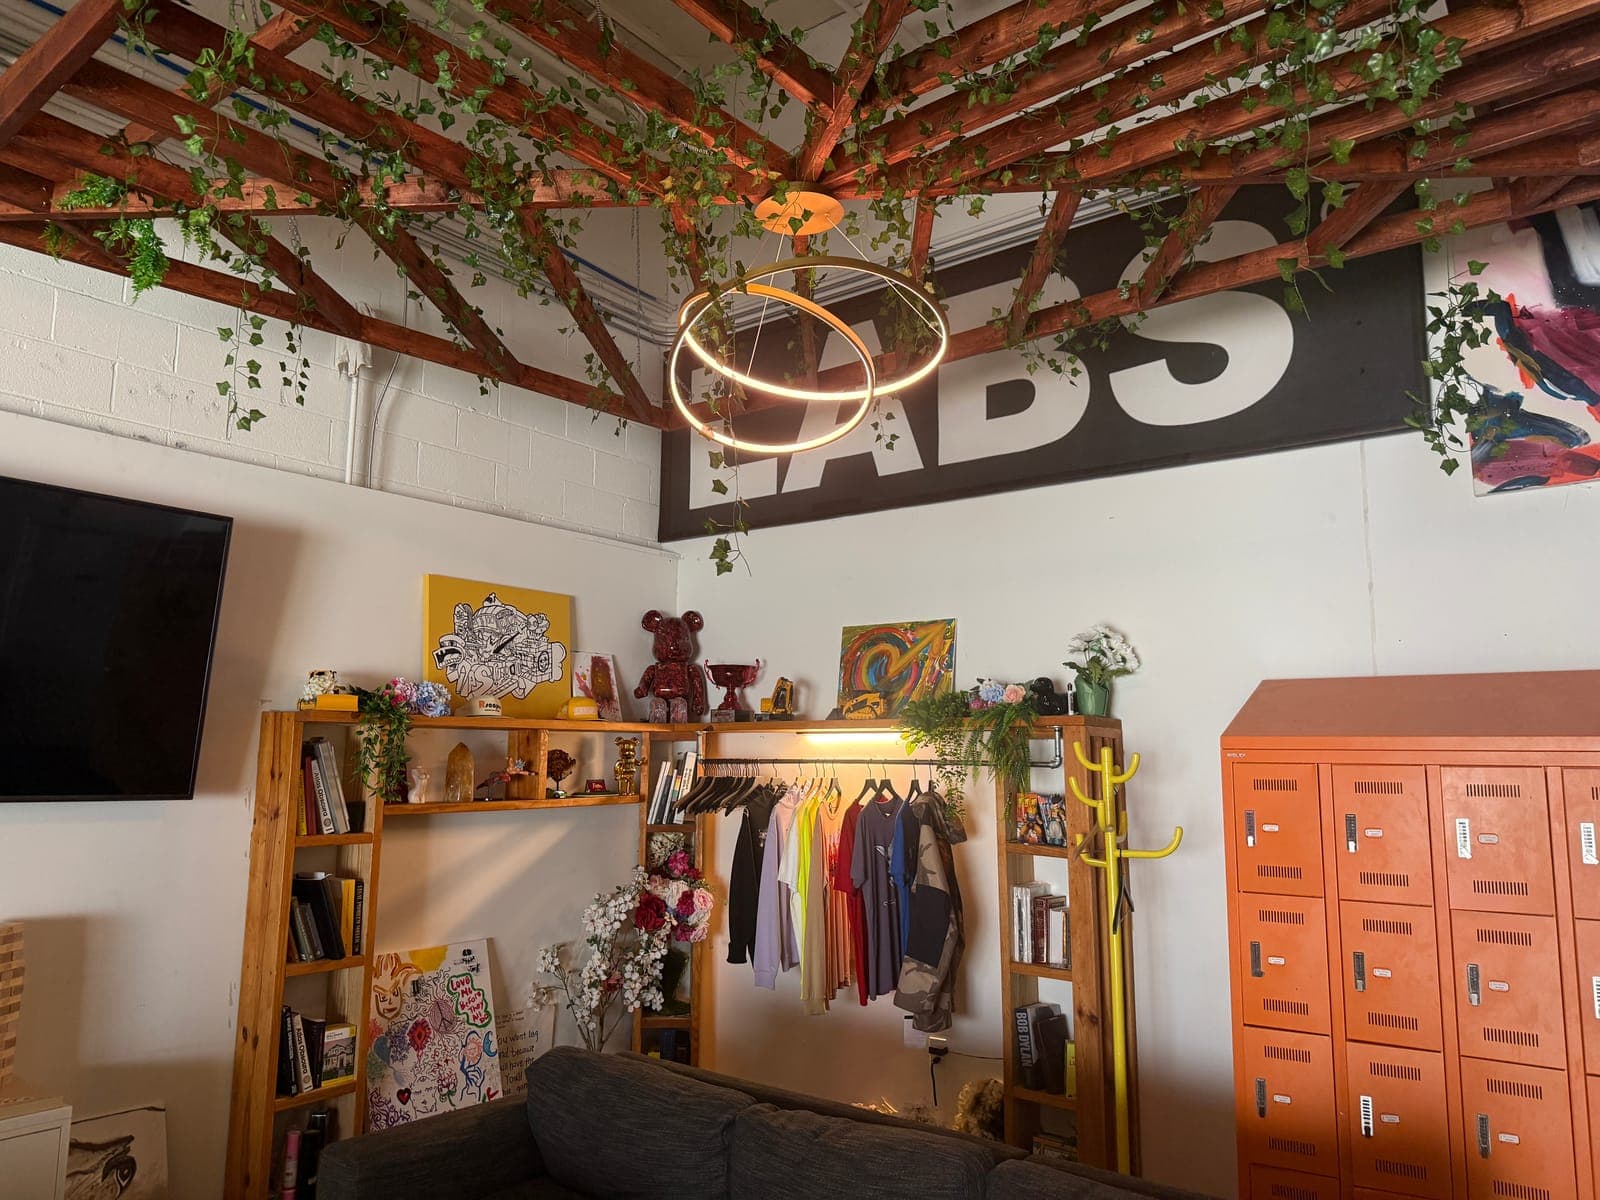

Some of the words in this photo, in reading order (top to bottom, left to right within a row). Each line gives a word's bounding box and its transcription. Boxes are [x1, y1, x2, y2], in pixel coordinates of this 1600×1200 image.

[688, 219, 1295, 511] LABS
[1016, 1012, 1028, 1033] BOB
[1019, 1035, 1032, 1067] DYLAN
